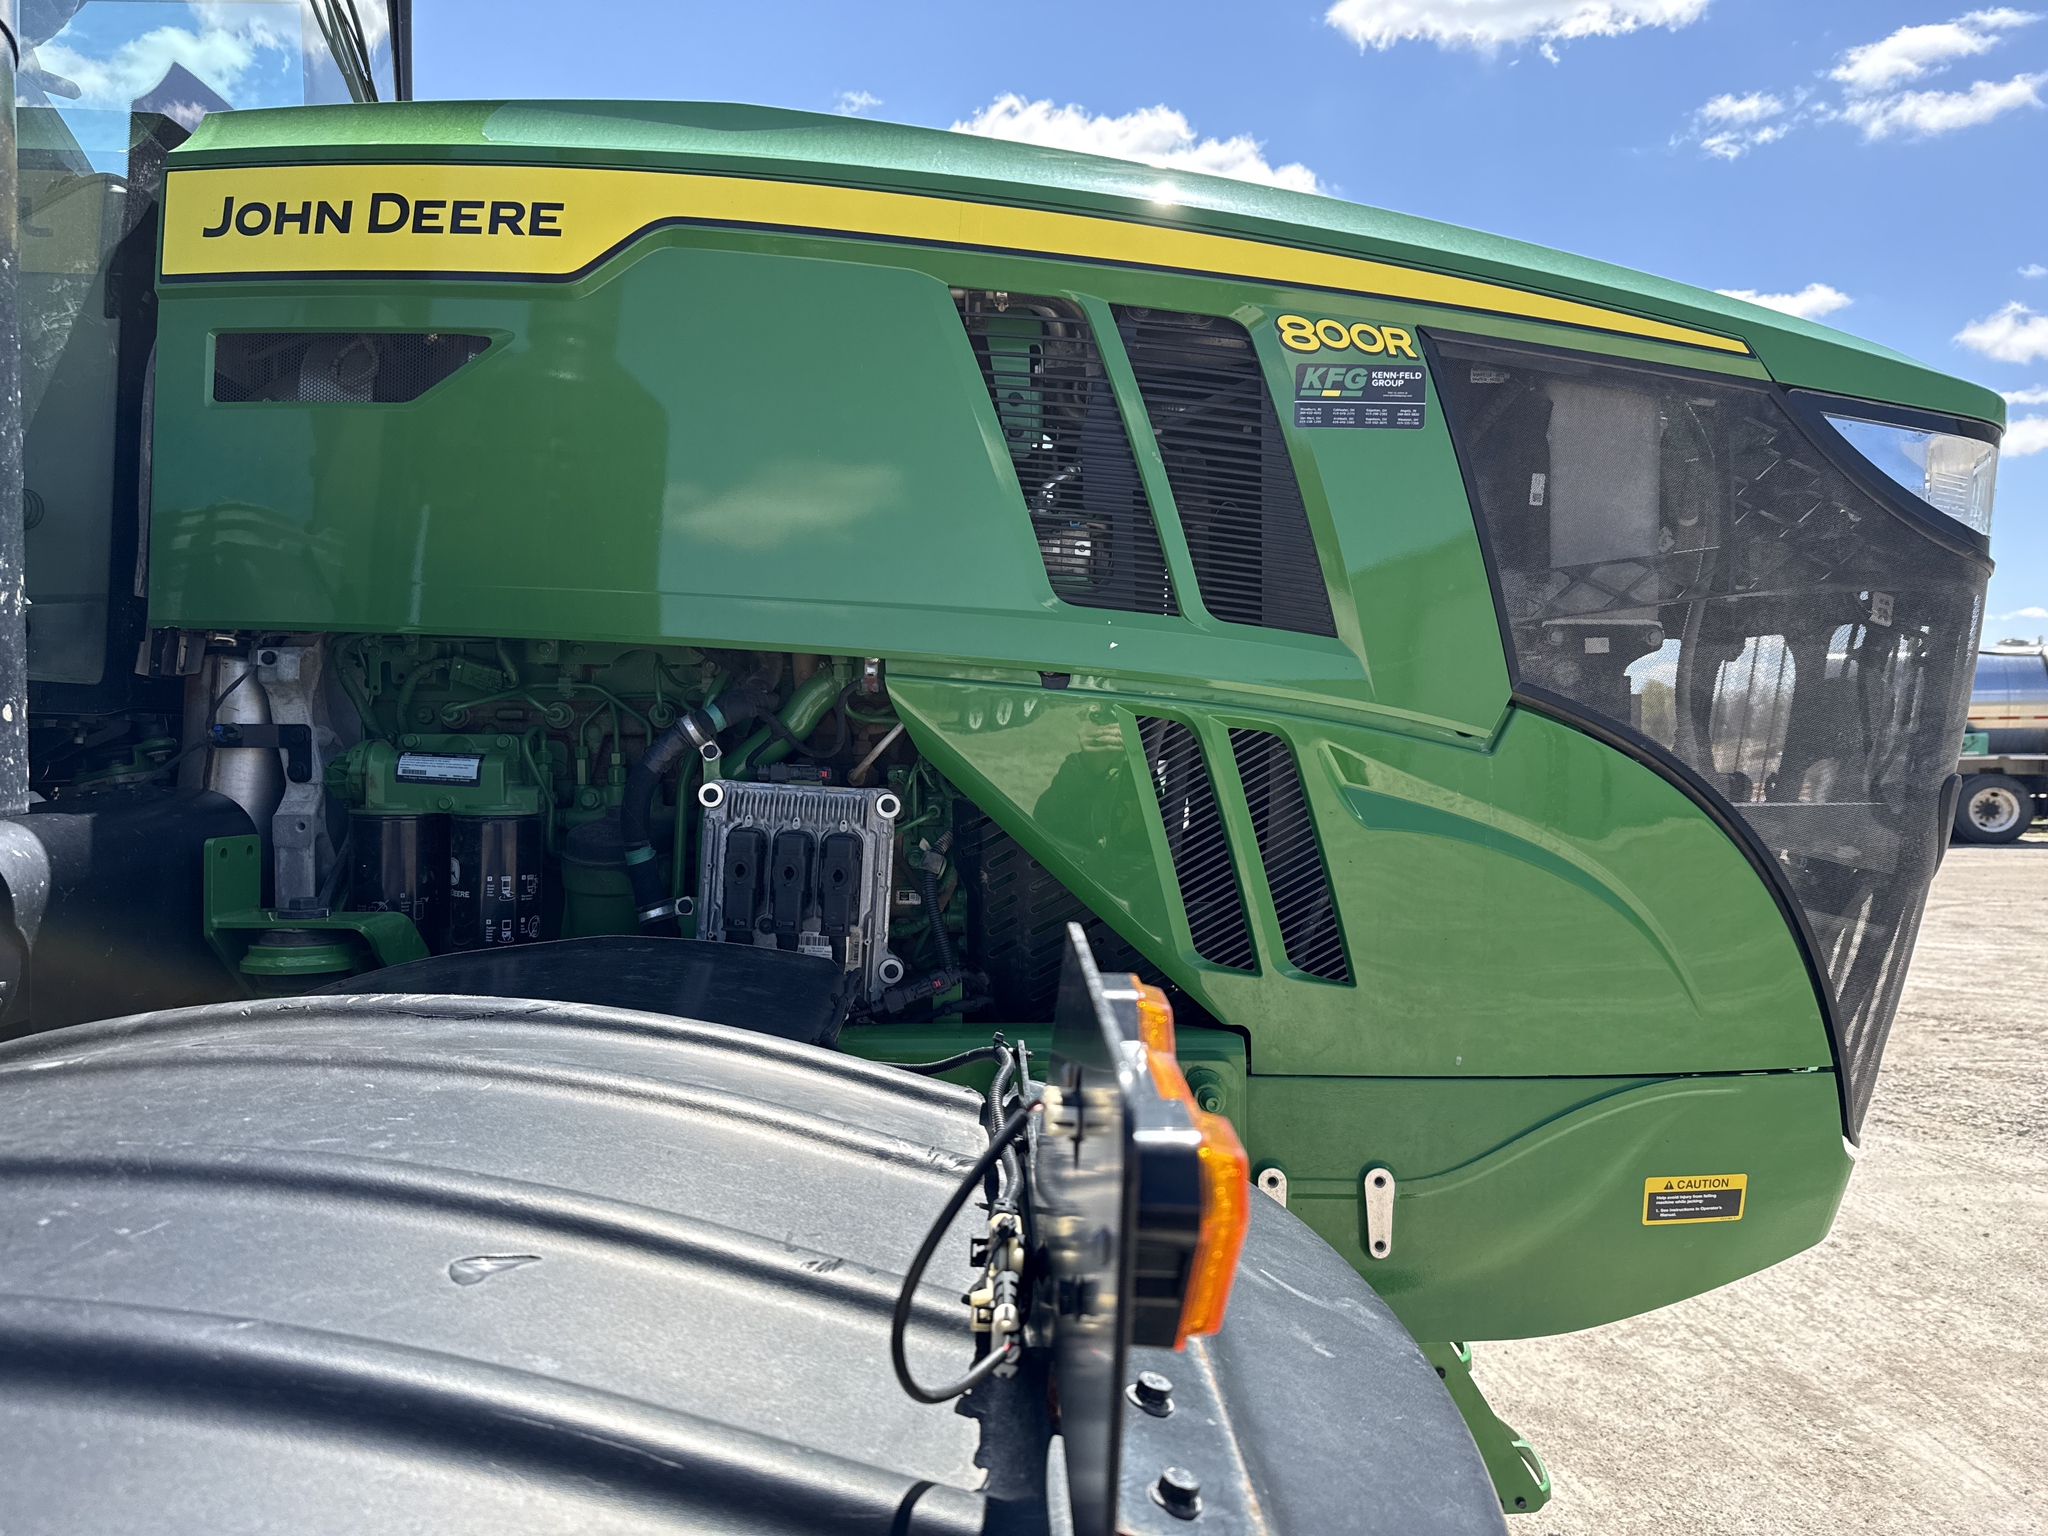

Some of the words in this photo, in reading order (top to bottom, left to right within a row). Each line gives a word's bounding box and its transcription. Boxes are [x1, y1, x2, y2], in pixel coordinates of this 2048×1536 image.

[202, 196, 353, 238] JOHN
[367, 192, 565, 237] DEERE
[1276, 314, 1419, 360] 800R
[1302, 367, 1368, 389] KFG
[1371, 371, 1422, 380] KENN-FELD
[1371, 379, 1404, 387] GROUP
[1677, 1178, 1729, 1189] CAUTION
